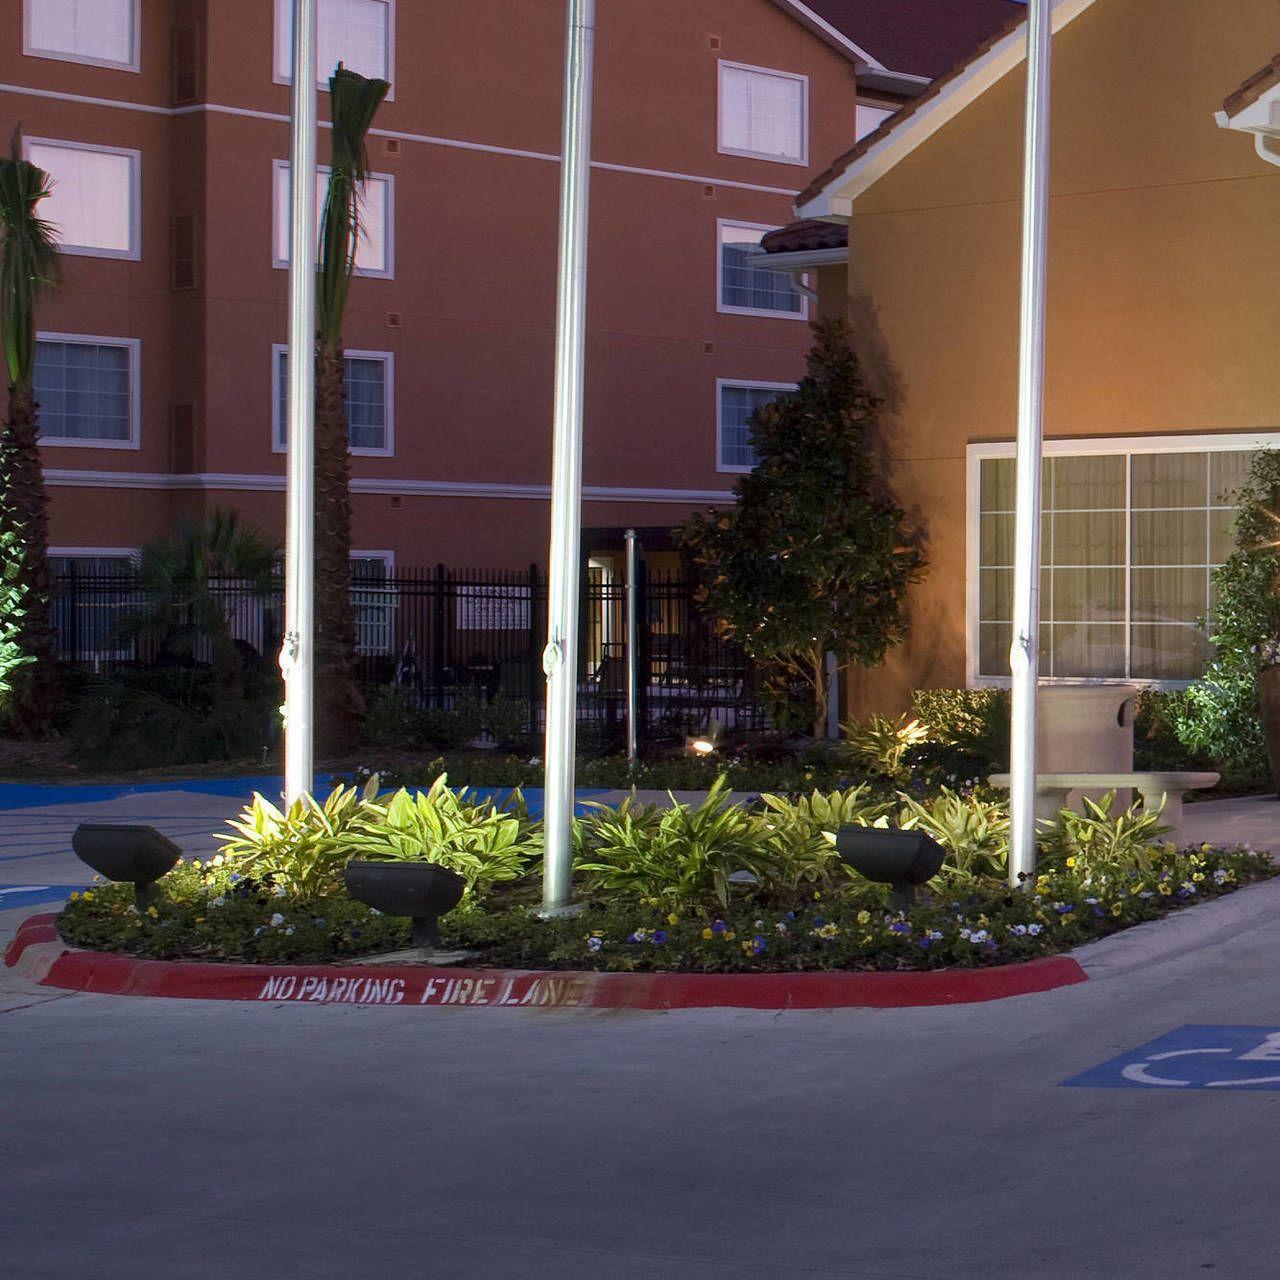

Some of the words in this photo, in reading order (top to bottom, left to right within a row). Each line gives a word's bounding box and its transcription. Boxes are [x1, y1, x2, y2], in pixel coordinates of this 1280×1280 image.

[258, 975, 297, 1000] NO
[295, 975, 406, 1004] PARKING
[419, 977, 496, 1005] FIRE
[500, 978, 586, 1006] LANE
